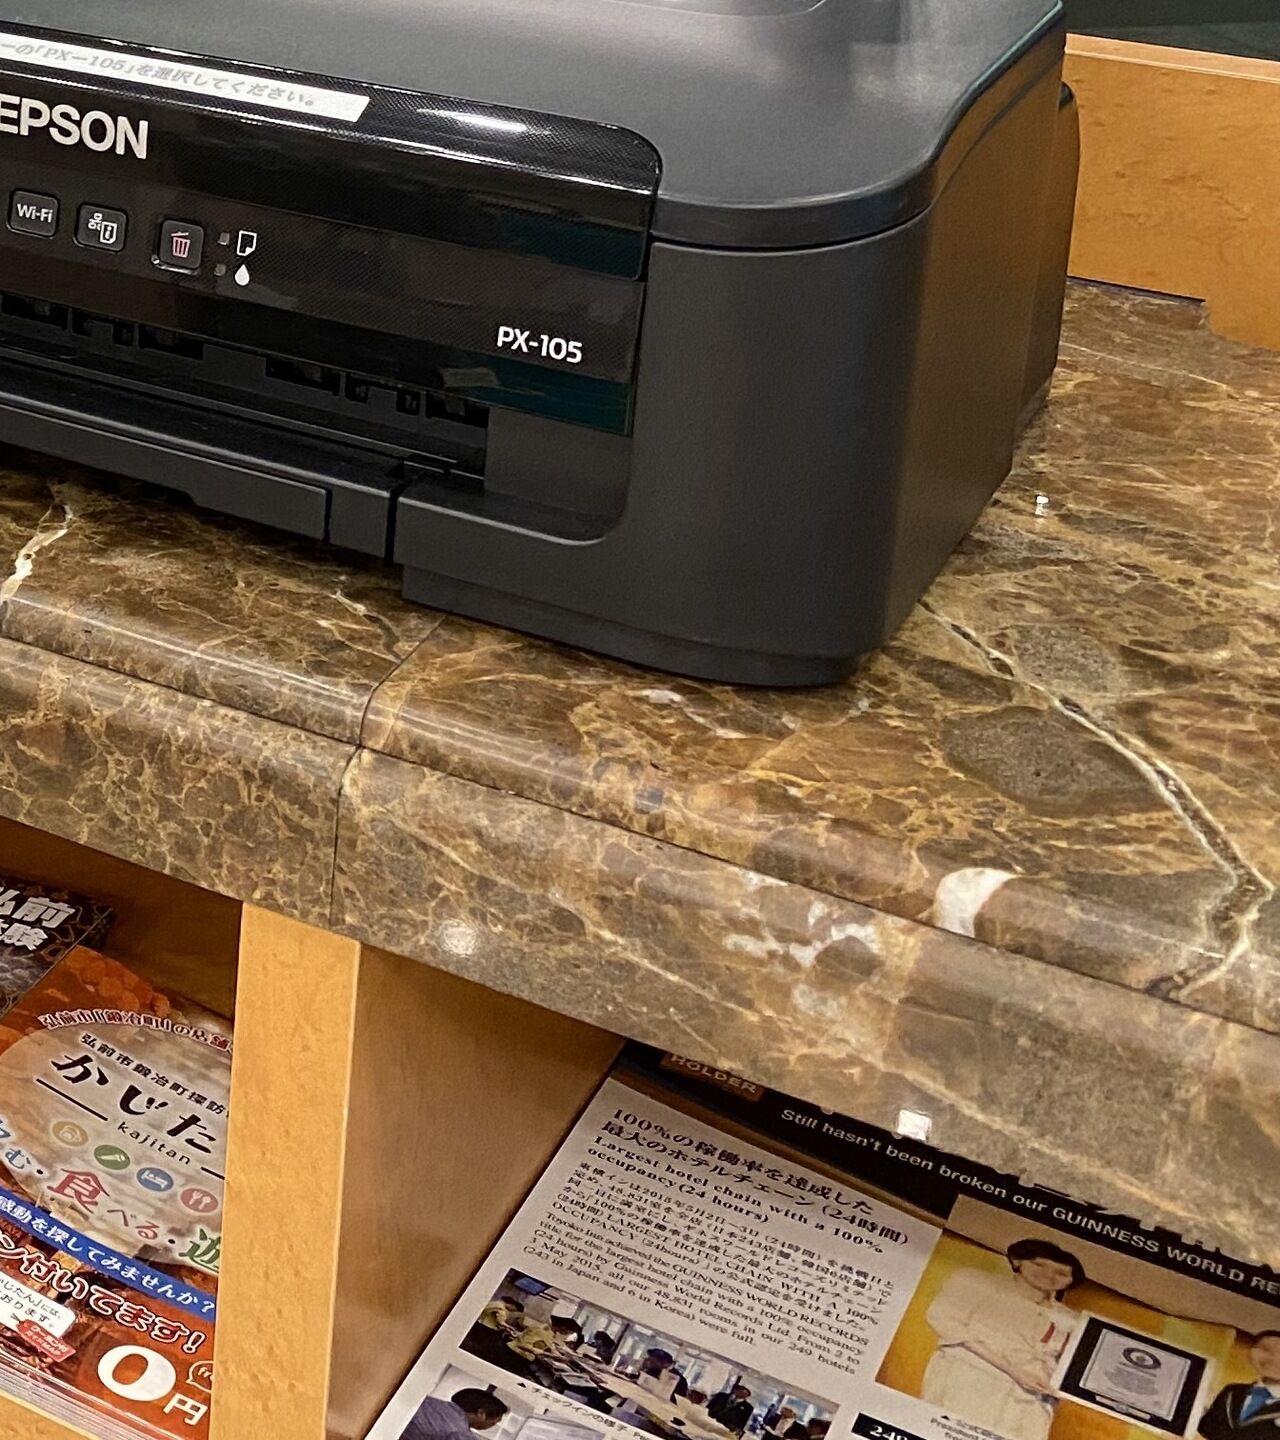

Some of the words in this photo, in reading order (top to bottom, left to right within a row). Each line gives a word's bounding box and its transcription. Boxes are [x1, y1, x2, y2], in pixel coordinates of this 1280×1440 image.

[16, 202, 53, 224] Wi-Fi
[496, 325, 584, 364] PX-105
[670, 1053, 758, 1095] HOLDER
[117, 1122, 193, 1167] kajitan
[591, 1135, 662, 1168] Largest
[663, 1164, 710, 1186] hotel
[711, 1182, 763, 1207] chain
[765, 1202, 810, 1225] with
[831, 1227, 886, 1253] 100%
[708, 1195, 770, 1224] hours)
[780, 1107, 818, 1131] Still
[821, 1115, 882, 1154] hasn't
[884, 1142, 934, 1172] been
[938, 1162, 1008, 1201] broken
[1012, 1192, 1048, 1214] our
[1051, 1204, 1160, 1255] GUINNESS
[1166, 1243, 1246, 1285] WORLD
[538, 1241, 570, 1258] May
[697, 1307, 739, 1327] rooms
[563, 1262, 603, 1283] Japan
[604, 1213, 671, 1243] LARGEST
[671, 1239, 726, 1265] HOTEL
[723, 1260, 774, 1284] CHAIN
[777, 1280, 822, 1302] WITH
[604, 1248, 646, 1268] largest
[645, 1263, 679, 1281] hotel
[677, 1277, 715, 1296] chain
[714, 1291, 745, 1307] with
[611, 1261, 671, 1288] Guinness
[671, 1284, 712, 1305] World
[711, 1300, 765, 1326] Records
[669, 1262, 744, 1296] GUINNESS
[742, 1291, 801, 1318] WORLD
[797, 1313, 871, 1346] RECORDS
